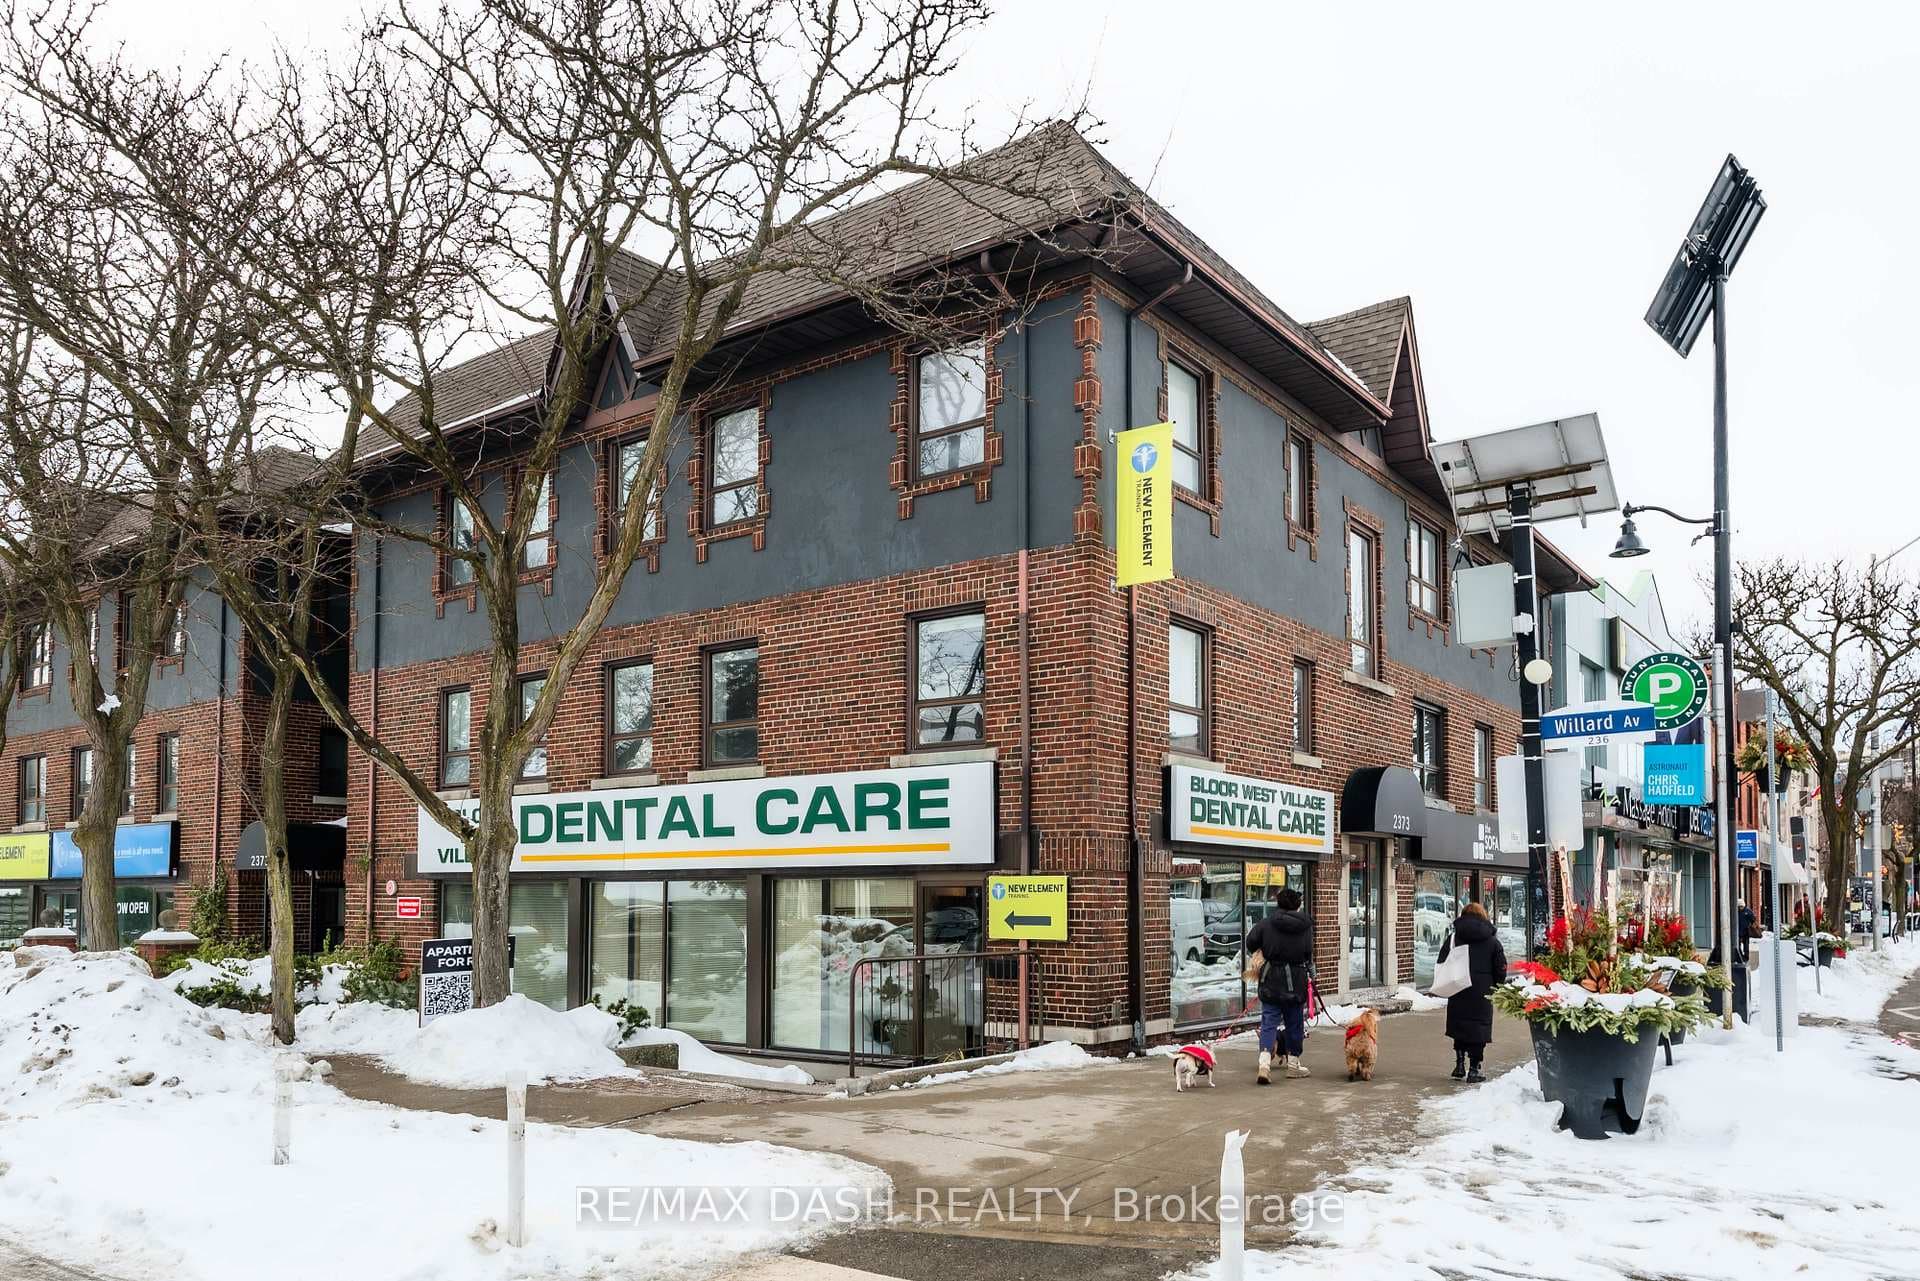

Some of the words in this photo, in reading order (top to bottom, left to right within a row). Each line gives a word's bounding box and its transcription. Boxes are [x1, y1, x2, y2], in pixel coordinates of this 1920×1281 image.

[1143, 477, 1153, 507] NEW
[1143, 509, 1153, 567] ELEMENT
[1624, 655, 1704, 691] MUNICIPAL
[1649, 672, 1682, 704] P
[1554, 714, 1614, 735] Willard
[1623, 714, 1640, 728] Av
[1588, 736, 1609, 745] 236
[1649, 762, 1688, 772] ASTRONAUT
[1648, 774, 1679, 785] CHRIS
[1190, 775, 1239, 798] BLOOR
[1241, 784, 1277, 803] WEST
[1280, 790, 1326, 811] VILLAGE
[1648, 784, 1695, 796] HADFIELD
[520, 793, 735, 844] DENTAL
[755, 778, 951, 835] CARE
[1190, 796, 1273, 830] DENTAL
[1278, 809, 1326, 836] CARE
[1393, 814, 1410, 830] 2373
[1484, 835, 1499, 851] SOFA
[1008, 884, 1027, 893] NEW
[1027, 884, 1064, 893] ELEMENT
[117, 902, 129, 914] OW
[129, 902, 149, 914] OPEN
[438, 957, 465, 968] FOR
